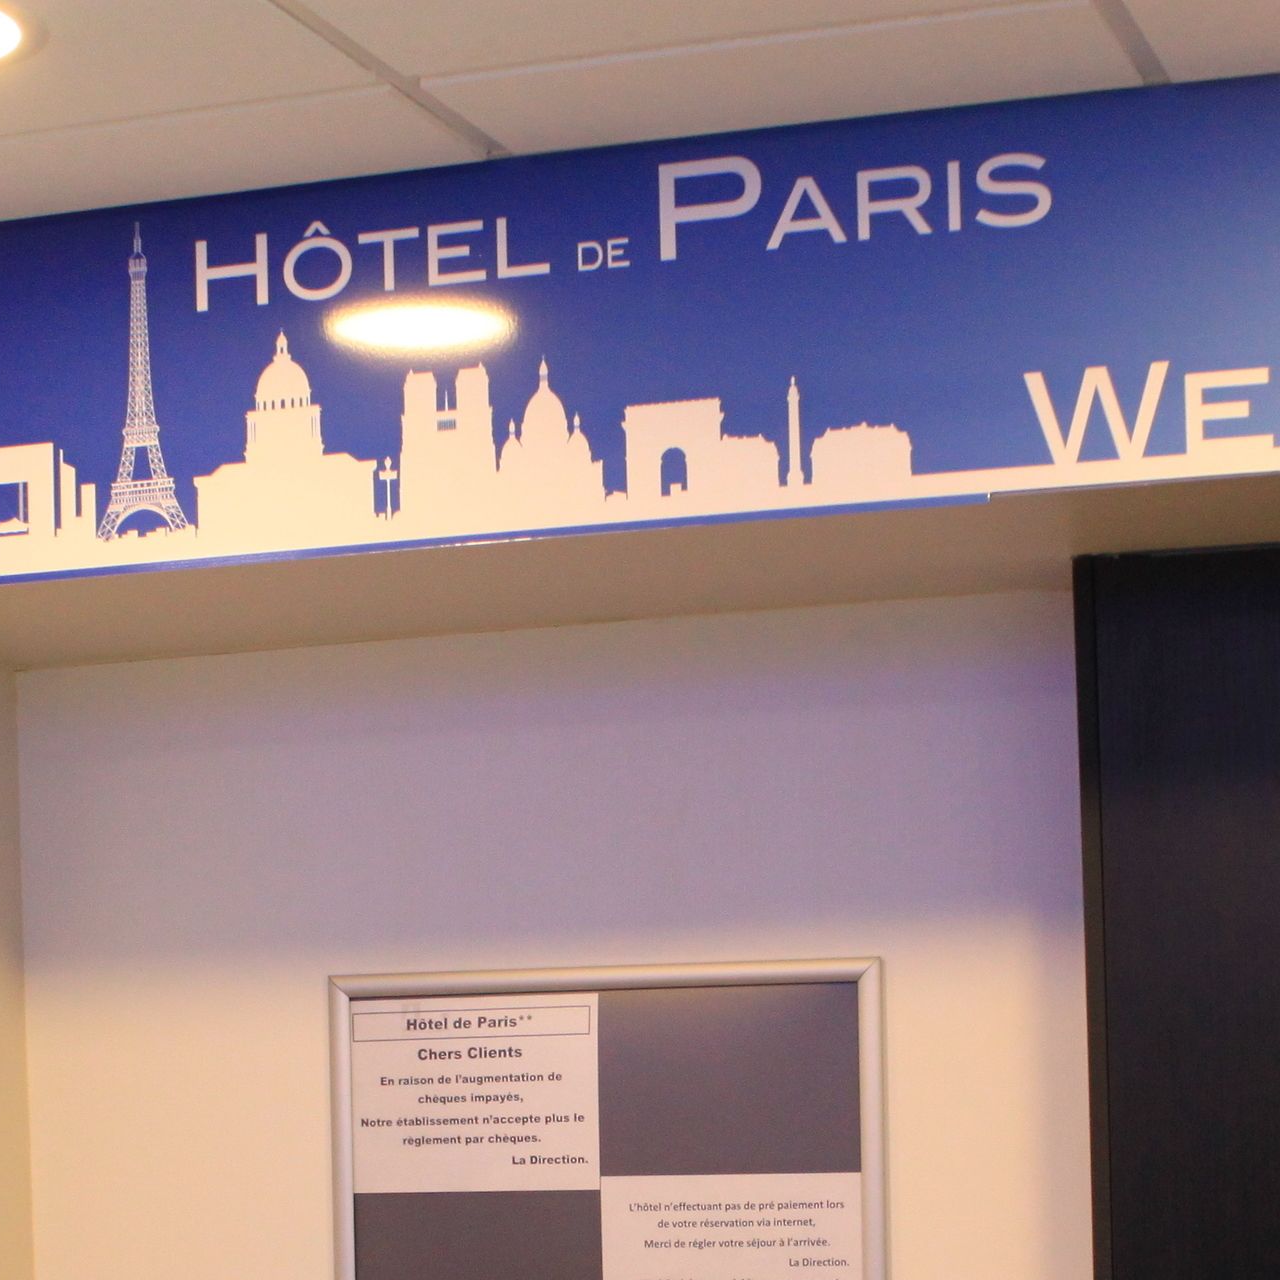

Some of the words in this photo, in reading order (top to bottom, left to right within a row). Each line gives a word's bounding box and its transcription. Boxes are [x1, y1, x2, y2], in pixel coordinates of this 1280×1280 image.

[194, 217, 551, 312] HÔTEL
[576, 237, 631, 273] DE
[658, 151, 1054, 262] PARIS
[407, 1017, 448, 1031] Hôtel
[453, 1018, 471, 1029] de
[417, 1048, 462, 1060] Chers
[468, 1046, 522, 1058] Clients
[380, 1077, 394, 1086] En
[398, 1075, 434, 1085] raison
[438, 1074, 451, 1084] de
[455, 1073, 543, 1084] l'augmentation
[548, 1072, 562, 1081] de
[471, 1092, 523, 1103] impayés,
[361, 1118, 392, 1127] Notre
[397, 1116, 478, 1126] établissement
[483, 1114, 541, 1125] n'accepte
[545, 1114, 569, 1124] plus
[574, 1113, 585, 1122] le
[465, 1136, 483, 1145] par
[512, 1156, 526, 1164] La
[530, 1155, 589, 1164] Direction.
[664, 1201, 722, 1212] n'effectuant
[725, 1203, 741, 1212] pas
[743, 1201, 756, 1210] de
[759, 1201, 775, 1212] pré
[778, 1200, 823, 1211] paiement
[826, 1200, 844, 1209] lors
[658, 1219, 670, 1228] de
[672, 1220, 697, 1228] votre
[700, 1218, 754, 1228] réservation
[757, 1218, 771, 1227] via
[773, 1218, 816, 1228] internet,
[644, 1239, 671, 1249] Merci
[674, 1239, 686, 1248] de
[689, 1239, 716, 1250] régler
[719, 1239, 744, 1248] votre
[747, 1238, 776, 1249] séjour
[779, 1237, 785, 1247] à
[787, 1237, 831, 1247] l'arrivée.
[789, 1258, 799, 1267] La
[802, 1257, 849, 1267] Direction.
